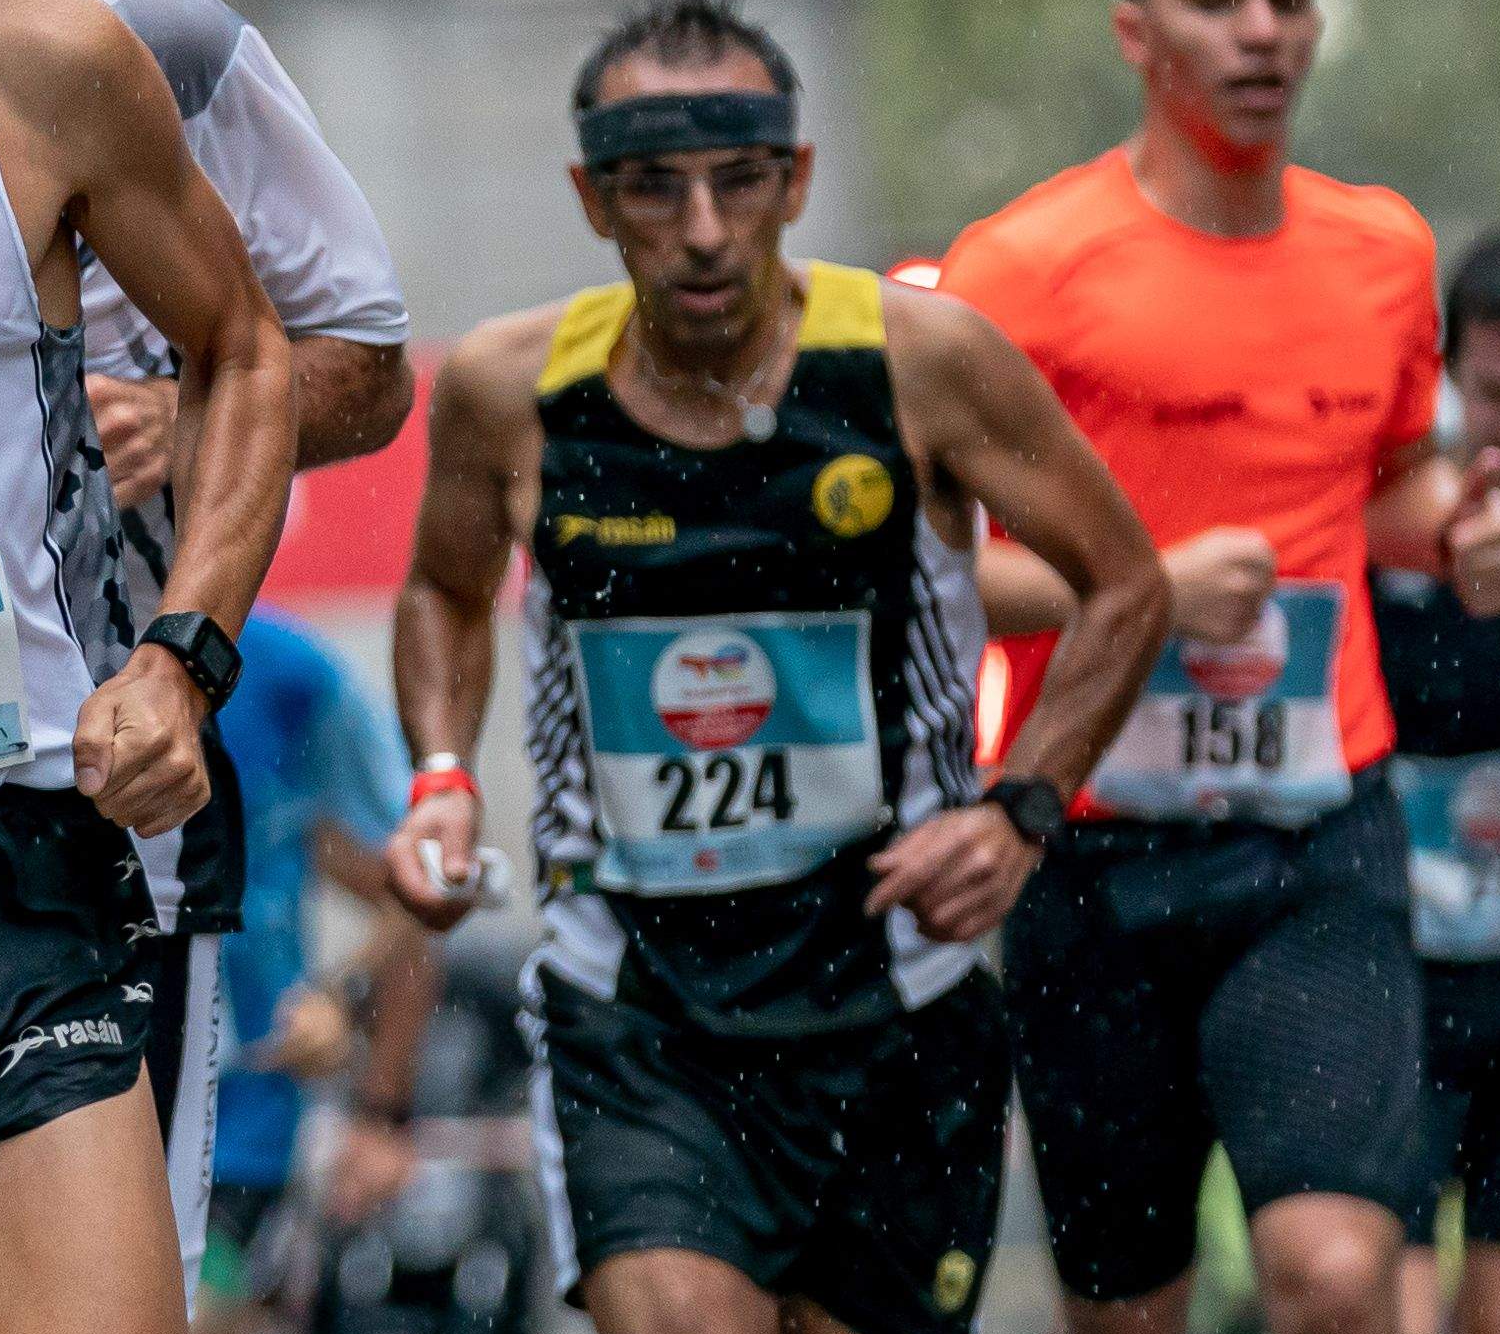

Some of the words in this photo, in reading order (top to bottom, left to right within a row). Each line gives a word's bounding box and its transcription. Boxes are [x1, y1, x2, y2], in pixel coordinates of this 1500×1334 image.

[1183, 701, 1286, 768] 158
[656, 753, 796, 831] 224
[53, 1013, 123, 1049] rasán
